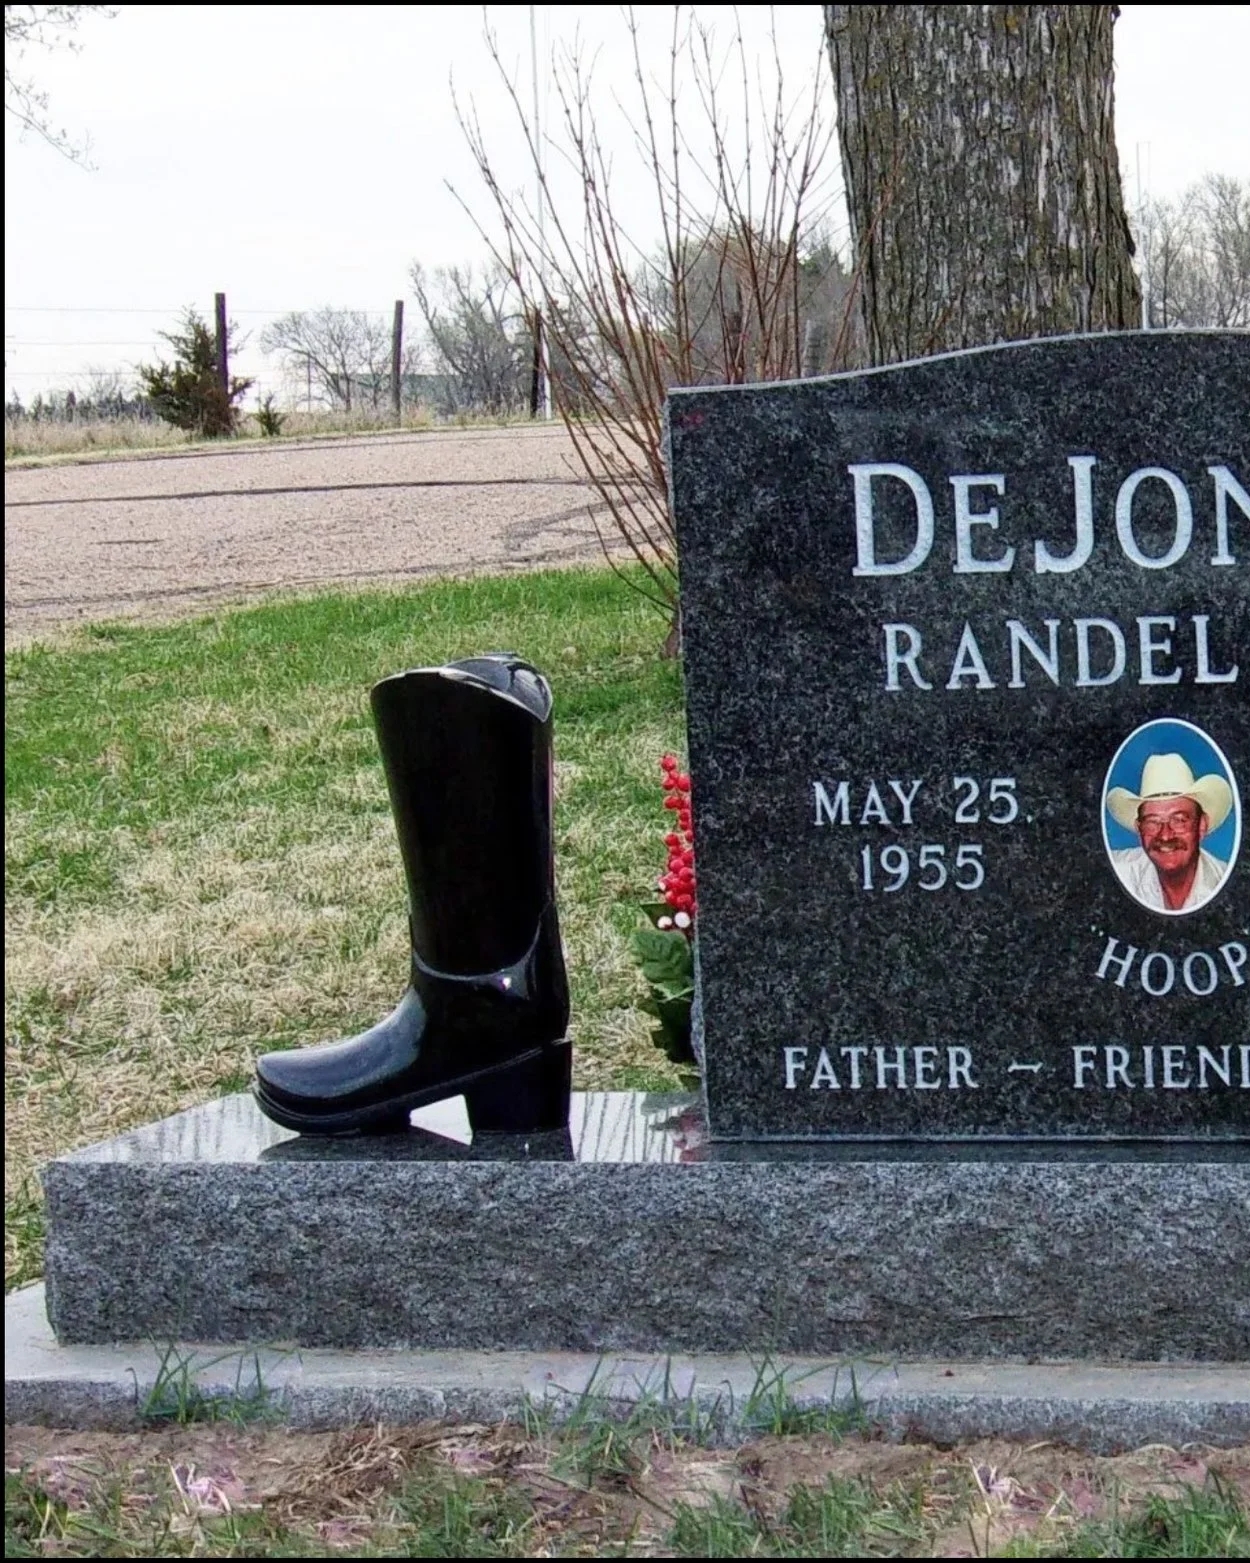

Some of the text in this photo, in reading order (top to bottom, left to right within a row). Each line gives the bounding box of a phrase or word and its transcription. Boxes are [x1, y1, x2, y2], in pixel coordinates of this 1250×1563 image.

[882, 615, 1239, 691] RANDEL
[812, 780, 922, 826] MAY
[860, 844, 985, 892] 1955
[784, 1045, 979, 1089] FATHER
